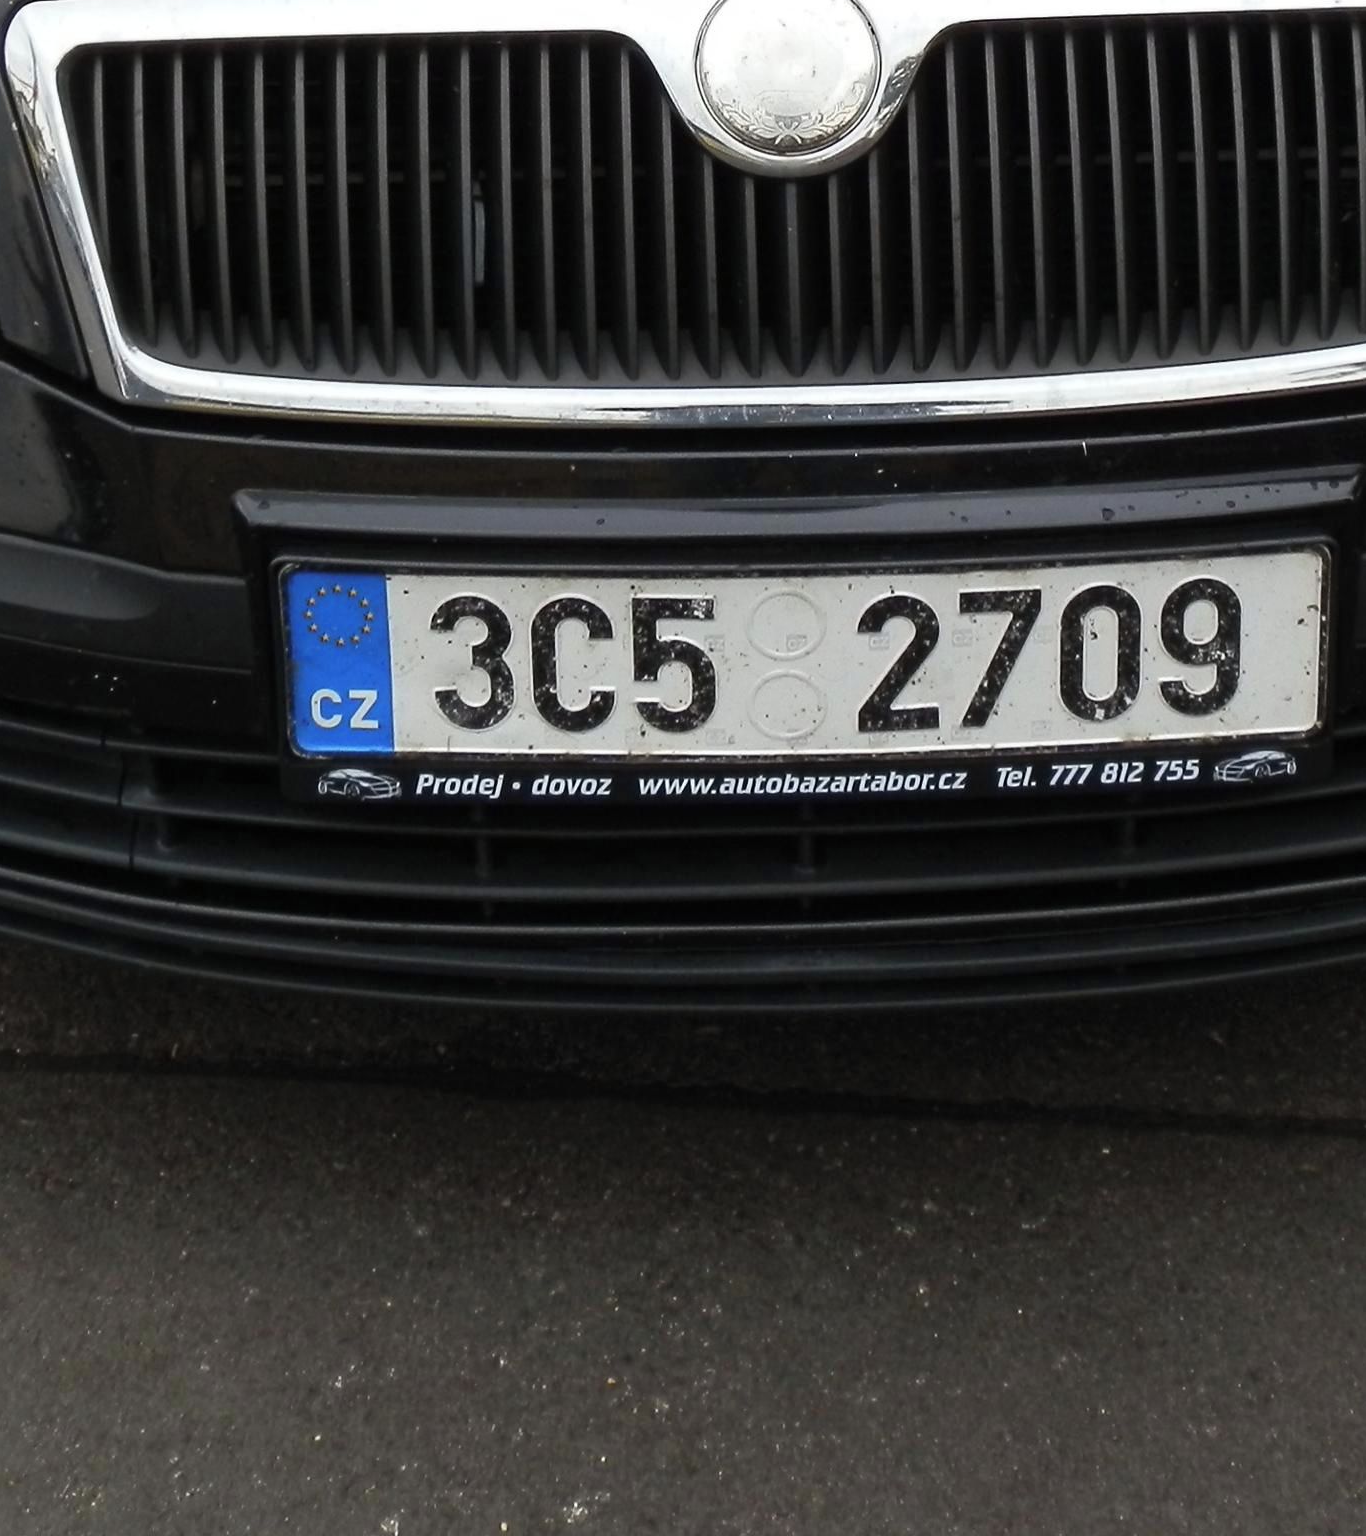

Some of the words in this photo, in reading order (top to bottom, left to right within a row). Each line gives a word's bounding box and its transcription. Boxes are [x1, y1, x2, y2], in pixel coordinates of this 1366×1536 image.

[430, 594, 717, 733] 3C5
[857, 577, 1243, 733] 2709
[310, 688, 379, 730] CZ
[415, 772, 504, 800] Prodej
[531, 772, 612, 797] dovoz
[638, 769, 966, 797] www.autobazartabor.cz
[997, 766, 1036, 789] Tel.
[1048, 764, 1094, 786] 777
[1100, 762, 1143, 784] 812
[1152, 759, 1201, 782] 755
